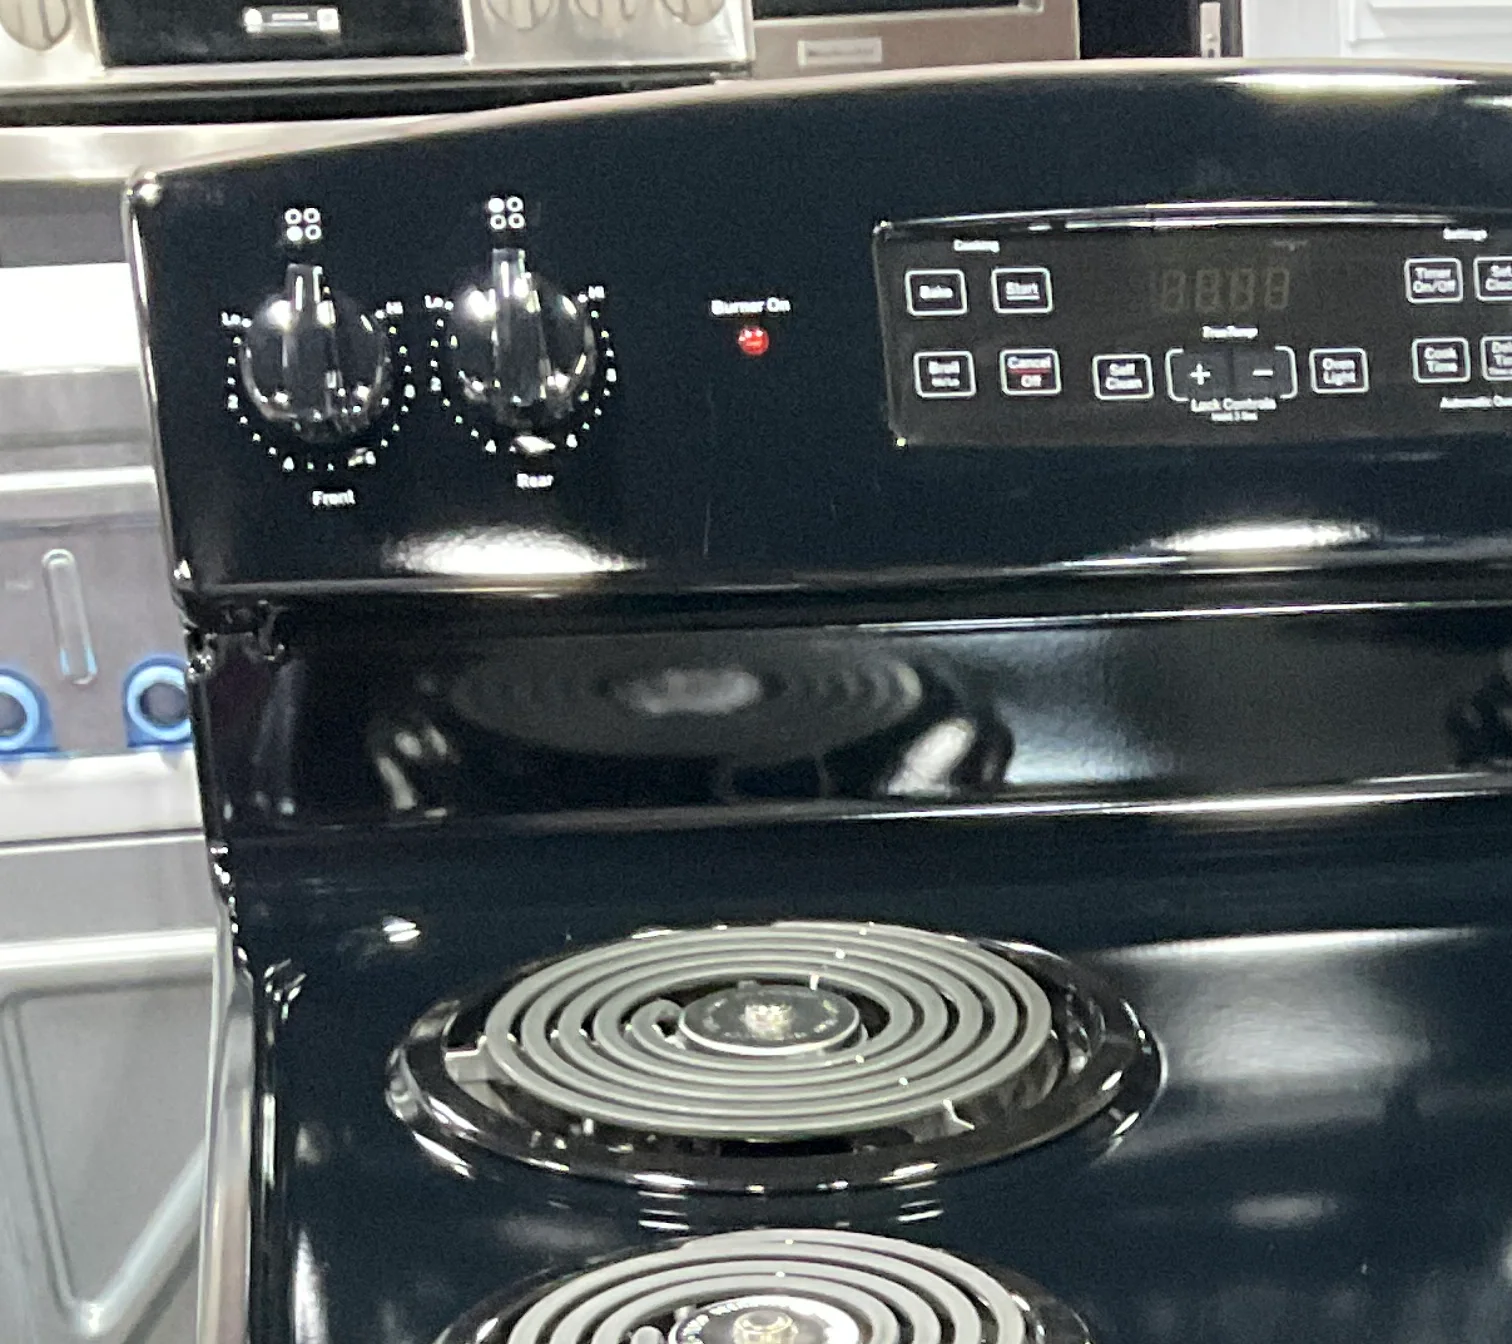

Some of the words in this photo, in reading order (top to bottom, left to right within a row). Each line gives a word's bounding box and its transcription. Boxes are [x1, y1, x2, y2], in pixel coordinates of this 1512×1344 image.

[1415, 267, 1451, 279] Timer
[1005, 281, 1038, 295] Start
[1413, 280, 1456, 293] On/Off
[711, 300, 764, 315] Burner
[767, 297, 790, 312] On
[1007, 356, 1051, 369] Cancel
[1191, 398, 1221, 413] Lock
[1223, 397, 1277, 411] Controls
[516, 473, 554, 488] Rear
[312, 490, 356, 506] Front
